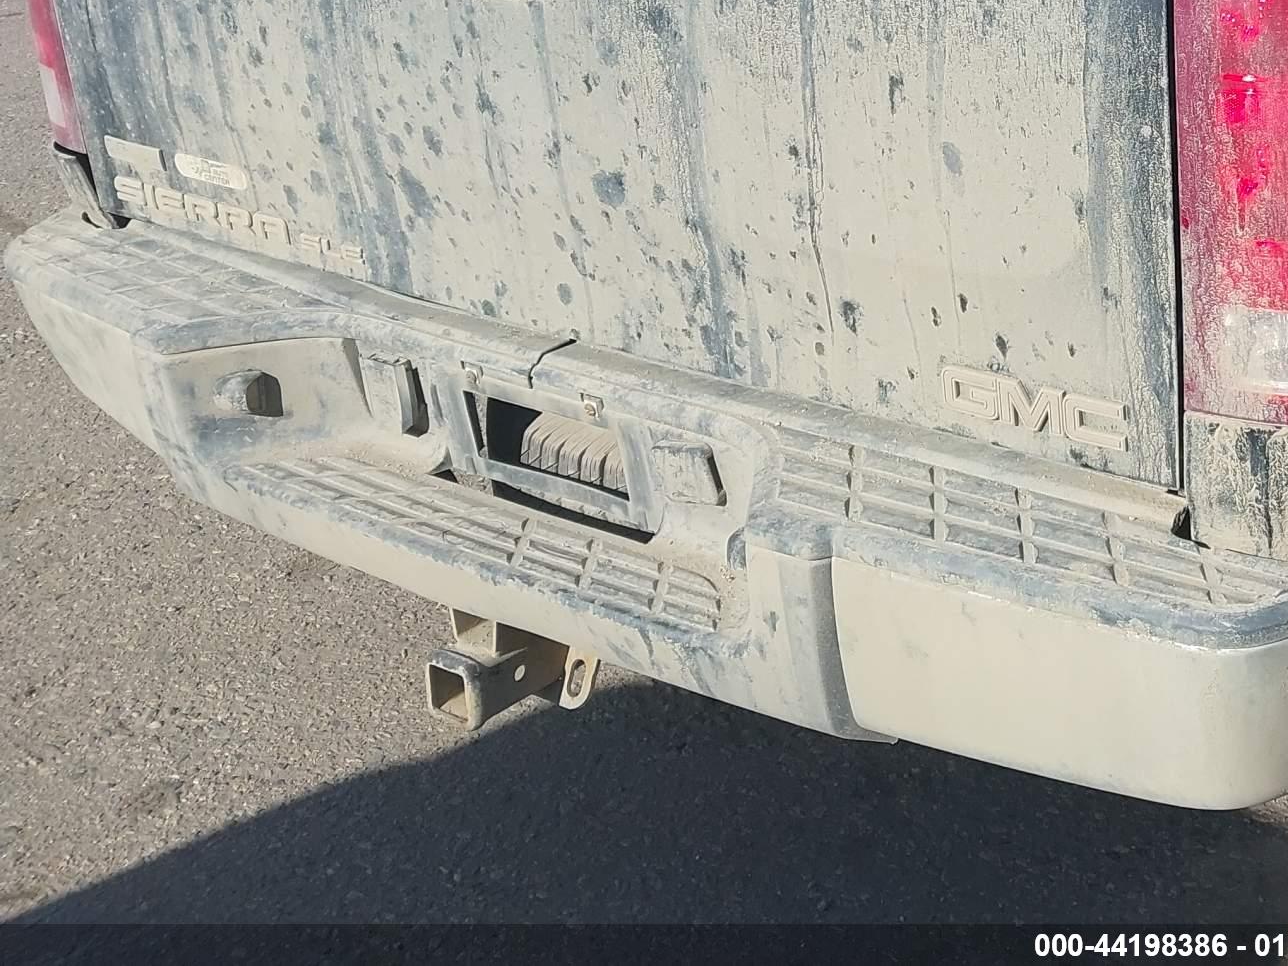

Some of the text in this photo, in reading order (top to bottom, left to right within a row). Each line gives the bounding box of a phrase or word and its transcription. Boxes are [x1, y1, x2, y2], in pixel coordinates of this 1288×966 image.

[114, 175, 365, 265] SIERRA SLE
[941, 365, 1128, 451] GMC
